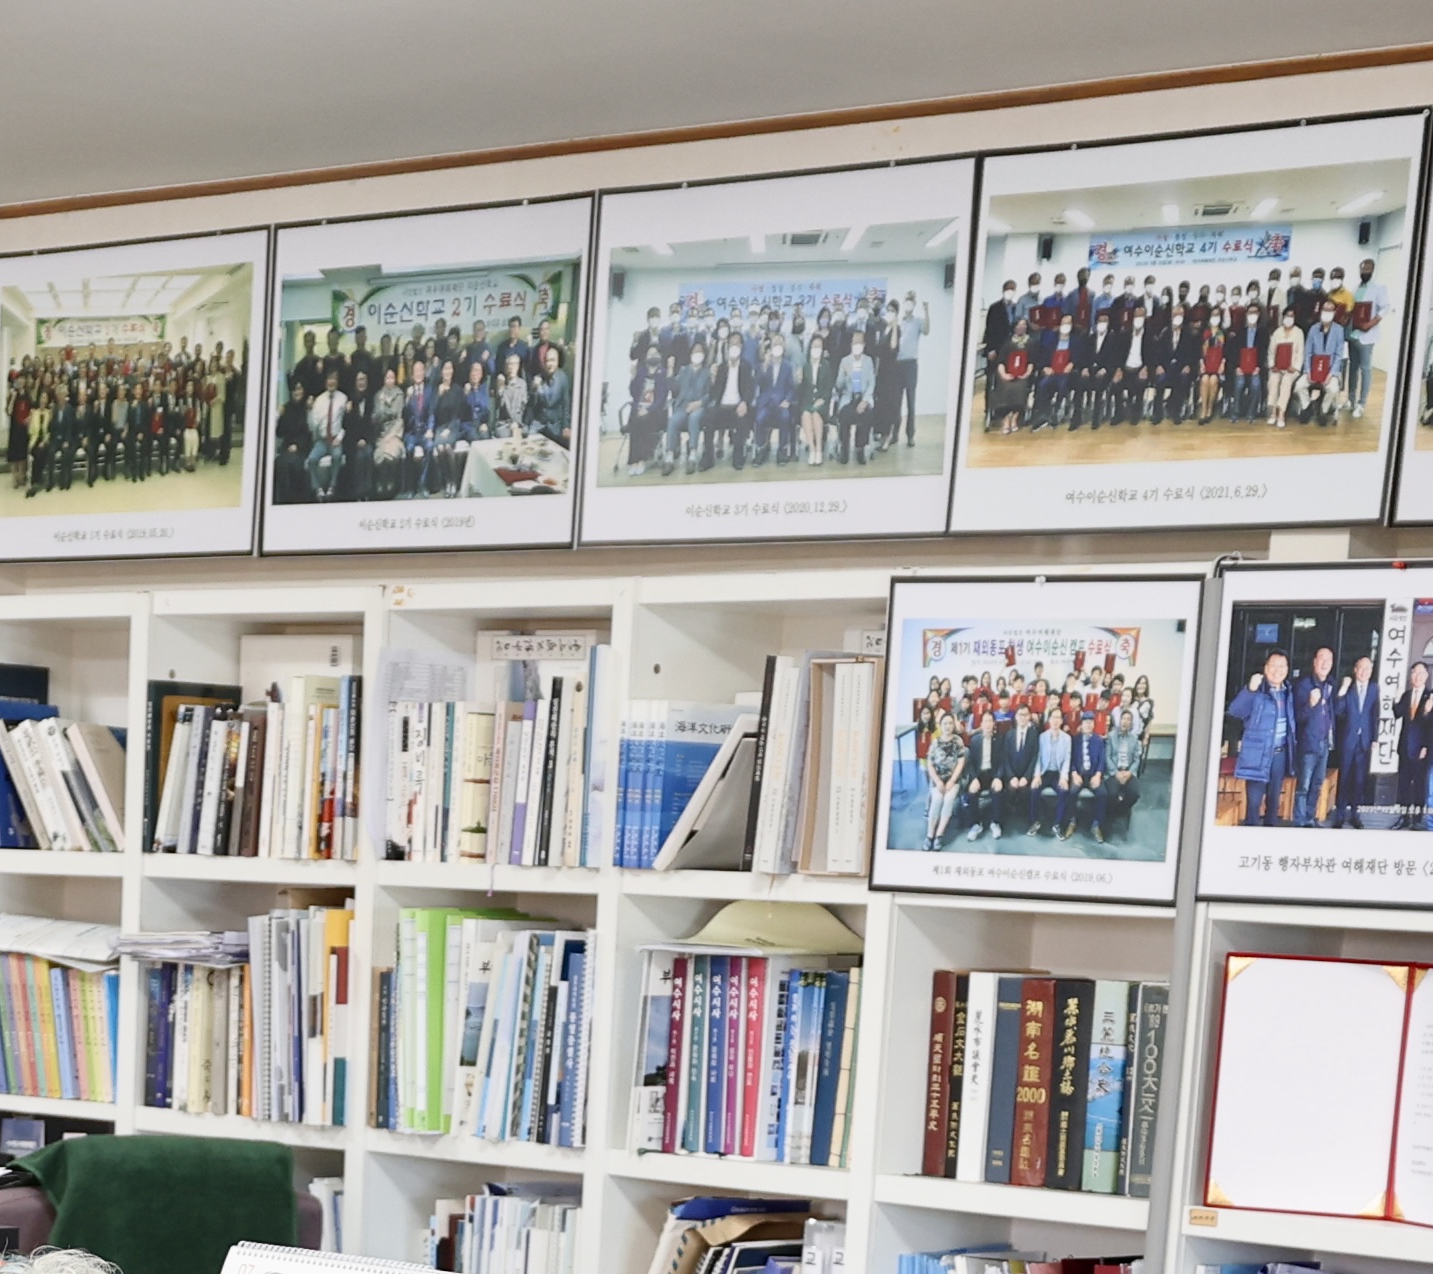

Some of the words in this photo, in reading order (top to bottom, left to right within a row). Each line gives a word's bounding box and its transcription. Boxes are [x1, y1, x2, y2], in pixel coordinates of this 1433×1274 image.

[1124, 242, 1195, 259] 여수이순신학교
[1199, 240, 1217, 255] 4기
[1222, 238, 1254, 254] 수료식
[342, 304, 356, 329] 경
[367, 299, 445, 325] 이순신학교
[452, 297, 477, 317] 2기
[483, 290, 527, 312] 수료식
[685, 502, 732, 518] 이순신학교
[752, 501, 781, 515] 수료식
[1064, 488, 1139, 505] 여수이순신학교
[1142, 487, 1159, 502] 4기
[1163, 486, 1195, 502] 수료식
[932, 639, 943, 658] 경
[950, 640, 971, 656] 제1기
[1238, 855, 1273, 873] 고기동
[1278, 856, 1337, 874] 행자부차관
[1341, 858, 1388, 877] 여해재단
[1393, 860, 1417, 878] 방문
[671, 976, 684, 1021] 여수시사
[692, 973, 704, 1018] 여수시사
[711, 974, 722, 1019] 여수시사
[729, 974, 740, 1020] 여수시사
[748, 976, 759, 1021] 여수시사
[1016, 1086, 1047, 1105] 2000
